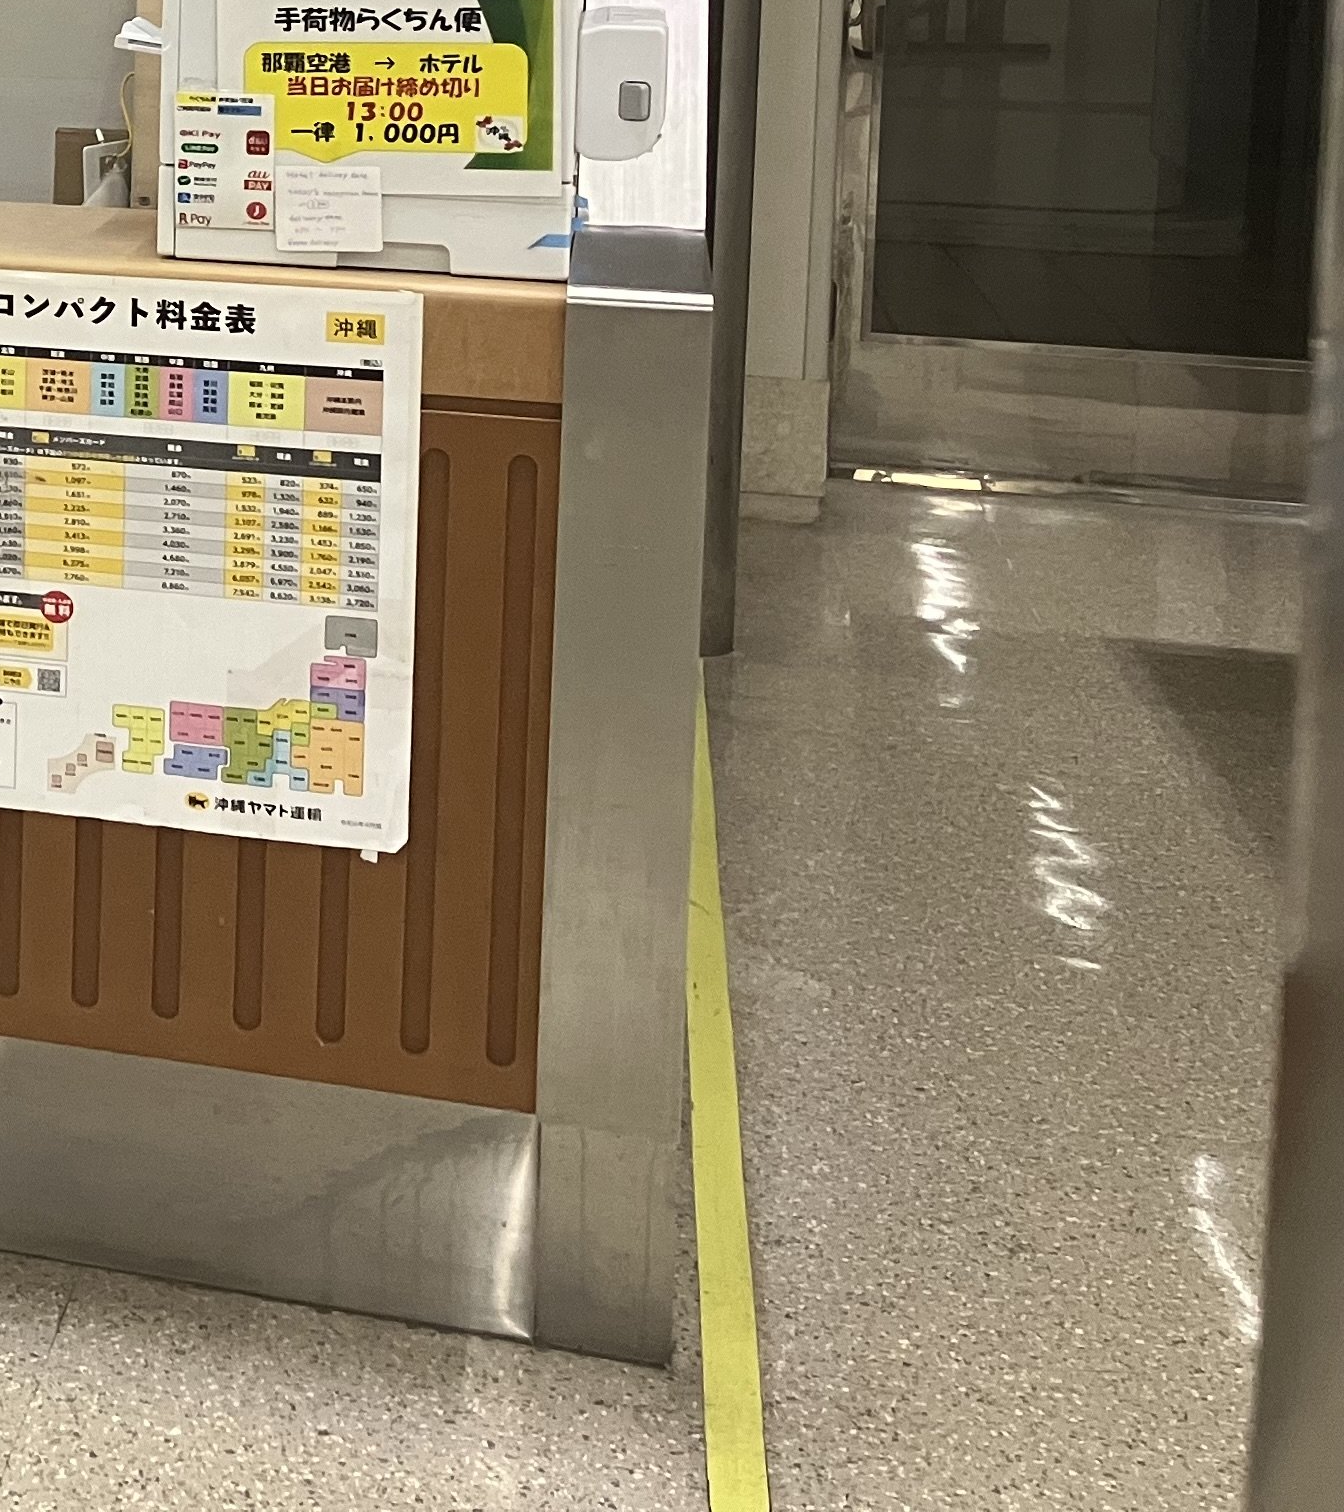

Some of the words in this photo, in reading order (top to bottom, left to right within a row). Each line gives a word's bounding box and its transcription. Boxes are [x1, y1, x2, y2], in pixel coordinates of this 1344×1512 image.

[274, 7, 481, 33] 手荷物らくちん便
[262, 52, 351, 73] 那覇空港
[420, 52, 483, 74] ホテル
[287, 77, 480, 98] 当日お届け締め切り
[346, 101, 424, 122] 13:00
[291, 122, 336, 143] 一律
[191, 213, 212, 226] Pay
[333, 317, 379, 339] 沖縄
[214, 796, 322, 821] 沖縄ヤマト運輸
